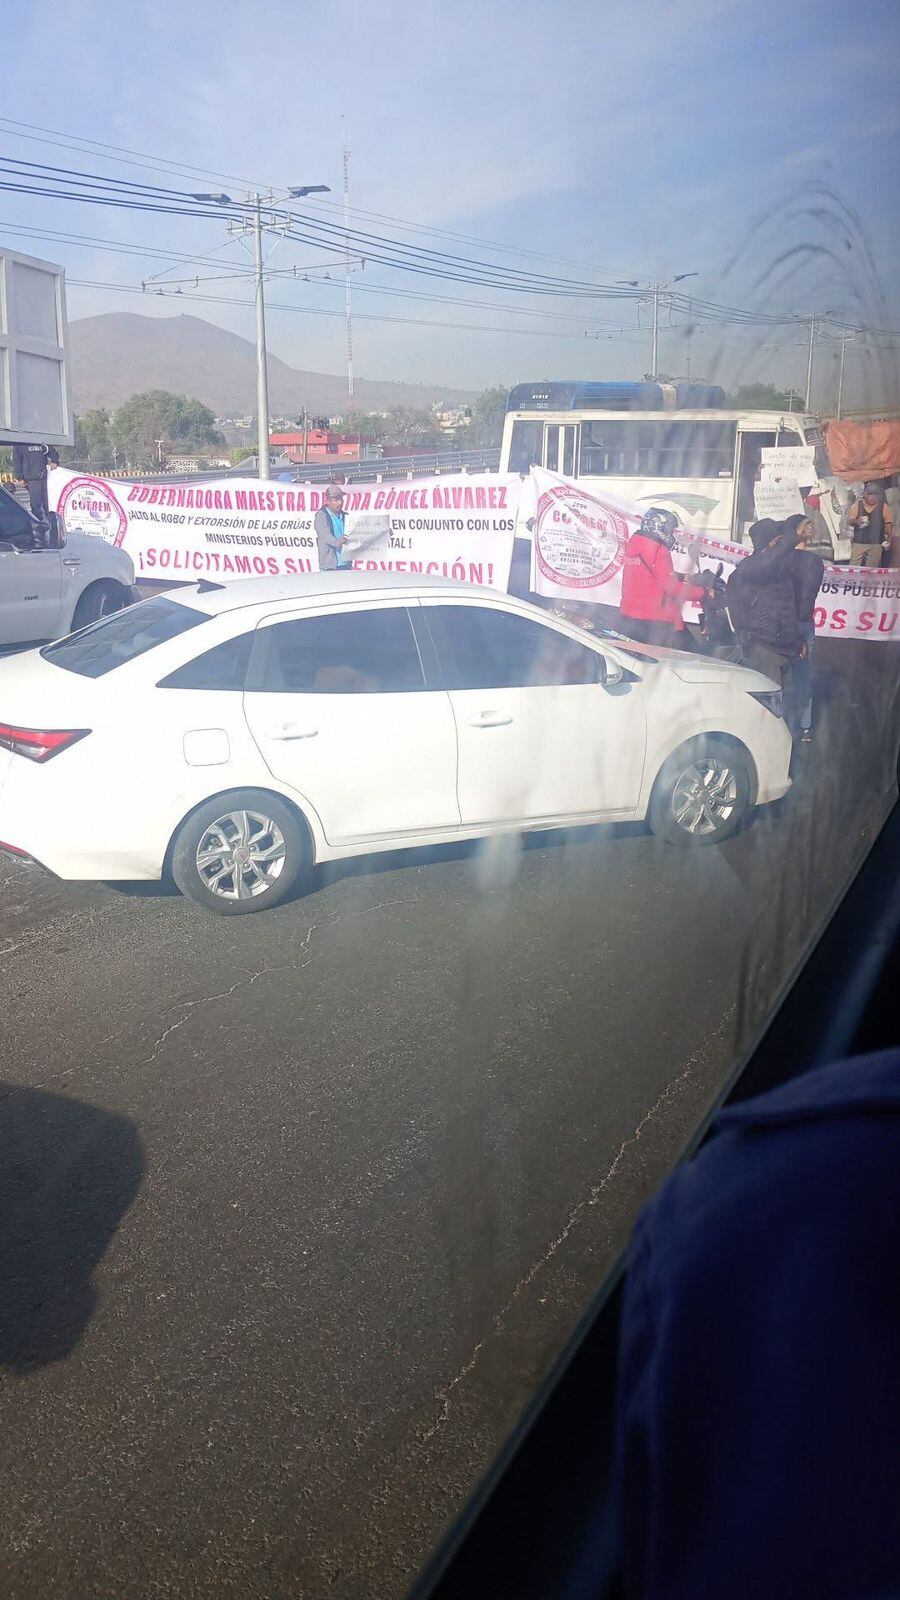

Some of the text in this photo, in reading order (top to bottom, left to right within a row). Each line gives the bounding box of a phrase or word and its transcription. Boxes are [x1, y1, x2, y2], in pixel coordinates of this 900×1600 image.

[127, 485, 233, 510] GOBERNADORA
[235, 490, 306, 512] MAESTRA
[374, 486, 429, 510] GÓMEZ
[432, 484, 507, 509] ÁLVAREZ
[128, 510, 149, 521] ¡ALTO
[150, 512, 160, 522] AL
[161, 513, 186, 525] ROBO
[187, 516, 194, 525] Y
[194, 516, 246, 529] EXTORSIÓN
[247, 520, 260, 529] DE
[261, 520, 279, 530] LAS
[280, 517, 312, 530] GRÚAS
[392, 519, 406, 530] EN
[408, 519, 464, 531] CONJUNTO
[466, 519, 490, 531] CON
[492, 519, 514, 531] LOS
[205, 532, 264, 546] MINISTERIOS
[264, 533, 314, 548] PÚBLICOS
[138, 547, 280, 575] ¡SOLICITAMOS
[855, 610, 898, 632] SU
